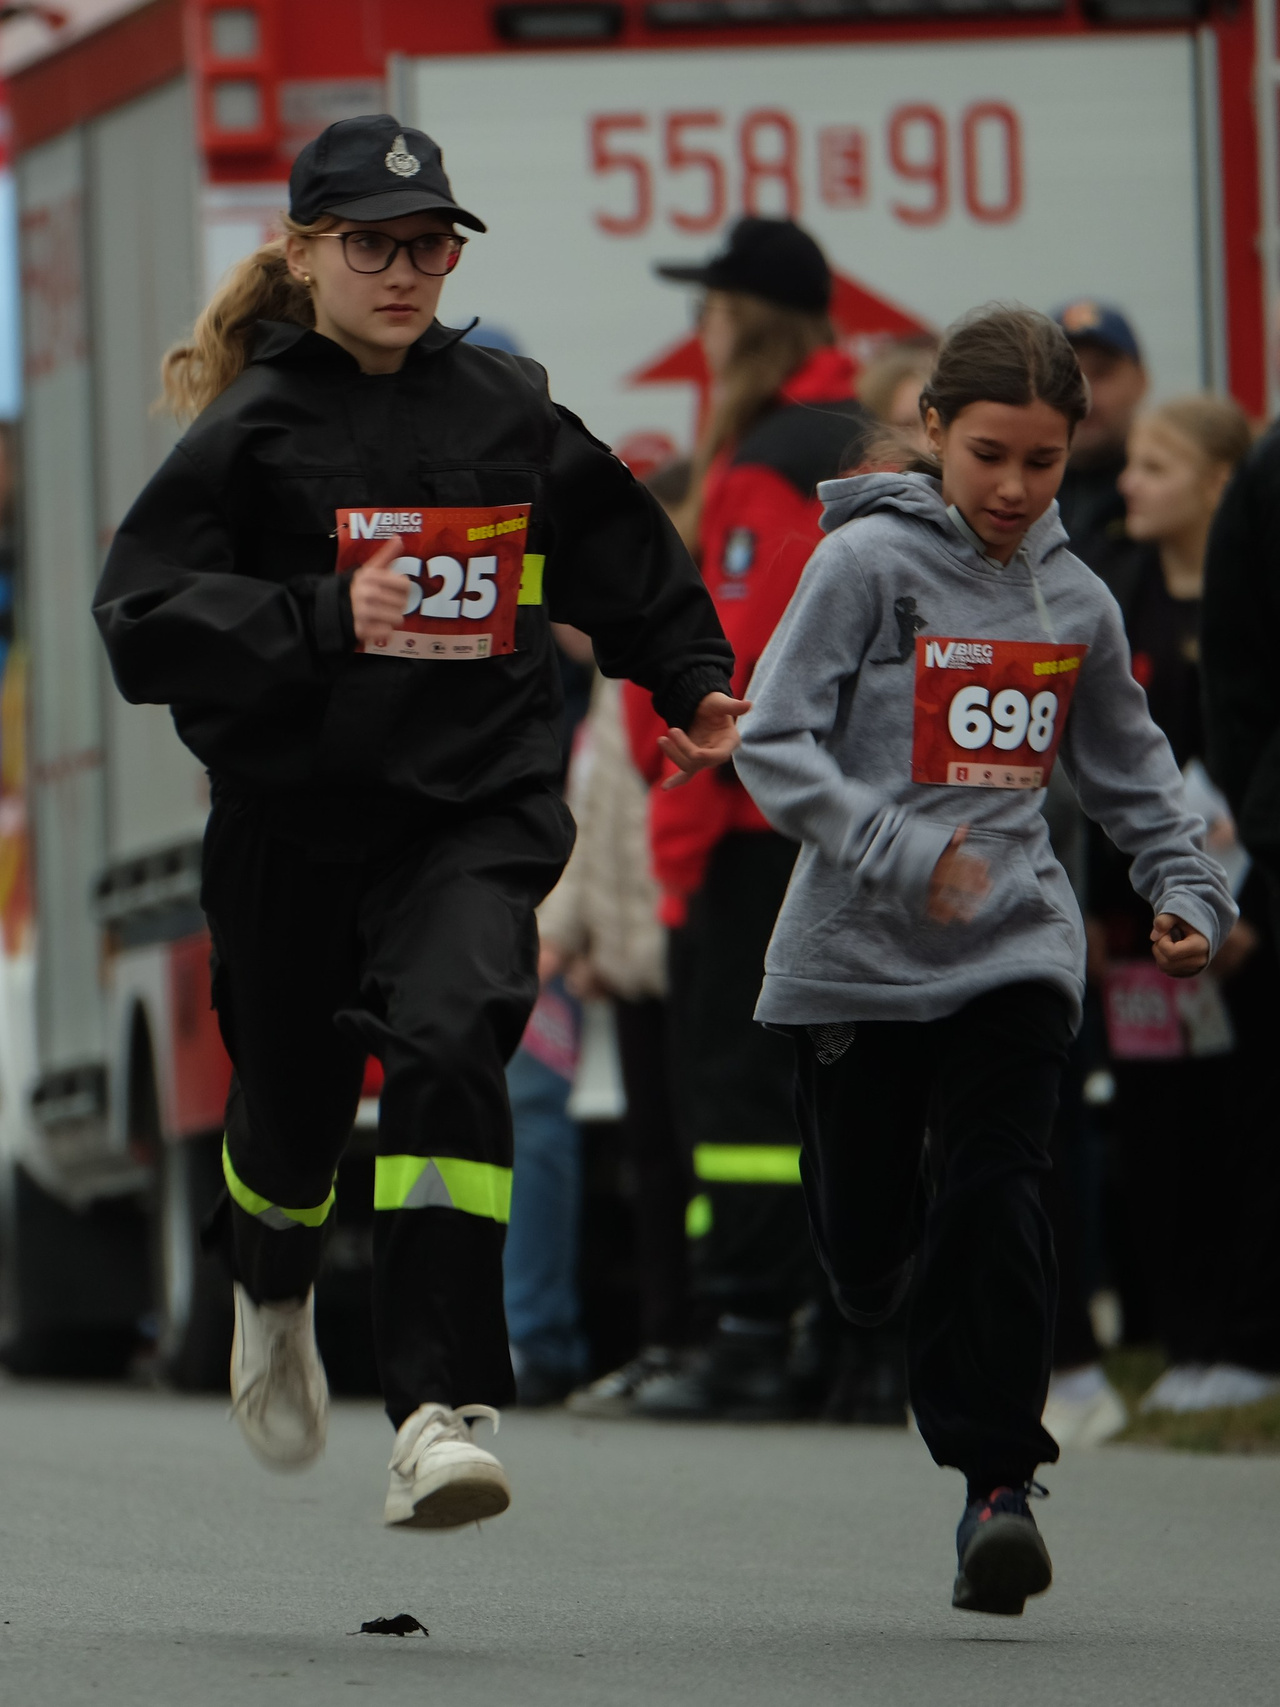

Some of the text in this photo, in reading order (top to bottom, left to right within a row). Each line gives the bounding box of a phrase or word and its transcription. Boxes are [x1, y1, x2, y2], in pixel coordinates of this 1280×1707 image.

[588, 107, 802, 238] 558
[887, 98, 1025, 228] 90
[348, 512, 422, 539] IV BIEG
[467, 516, 528, 541] BIEG DZIECI
[925, 641, 955, 668] IV
[954, 643, 994, 657] BIEG
[948, 685, 1059, 753] 698
